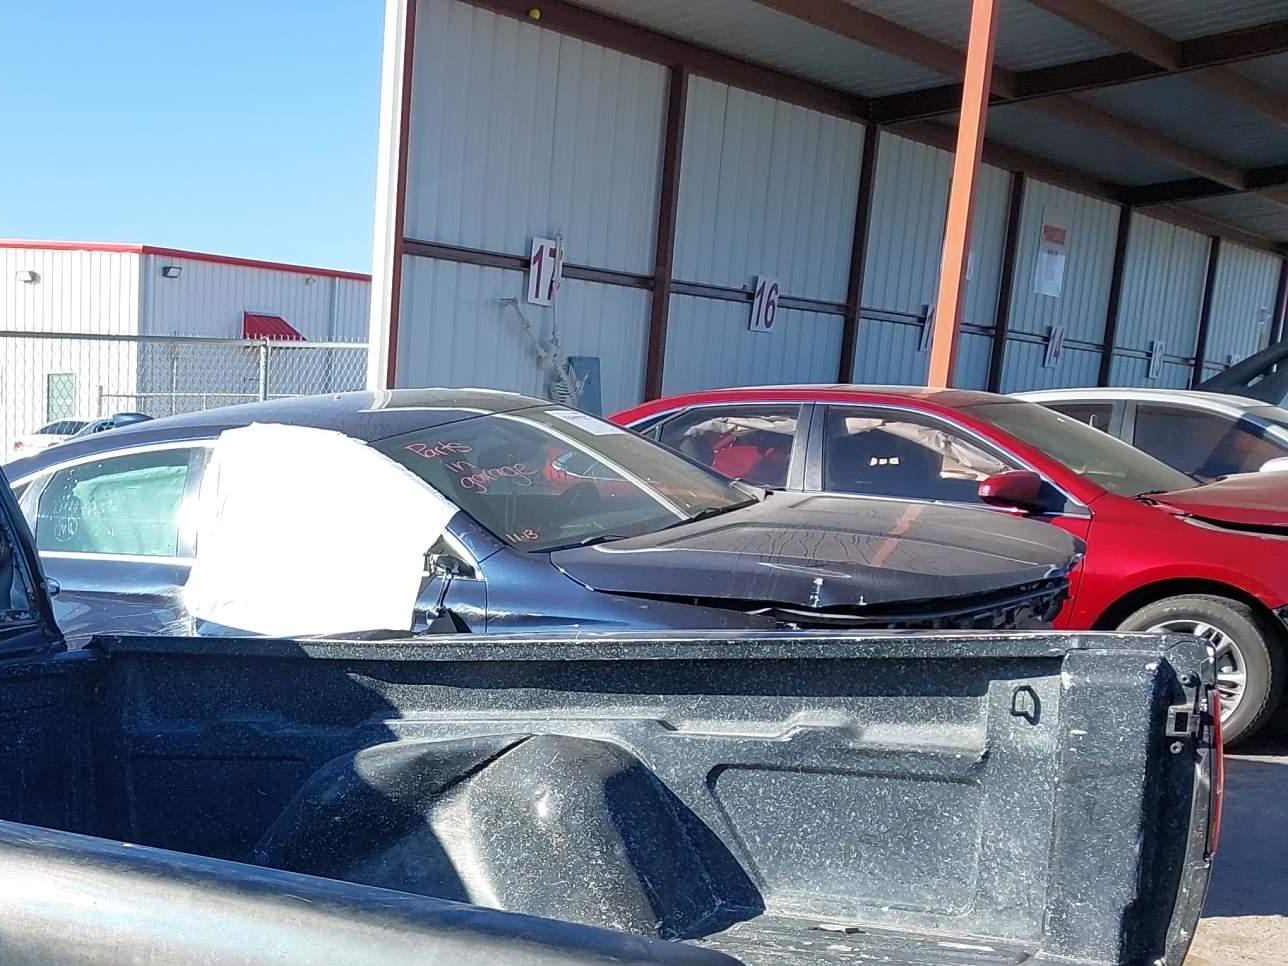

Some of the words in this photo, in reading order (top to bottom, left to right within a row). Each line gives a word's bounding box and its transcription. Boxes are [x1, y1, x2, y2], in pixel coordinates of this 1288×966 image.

[532, 244, 562, 300] 17
[754, 280, 779, 329] 16
[405, 440, 472, 459] Parts
[460, 461, 540, 494] garage
